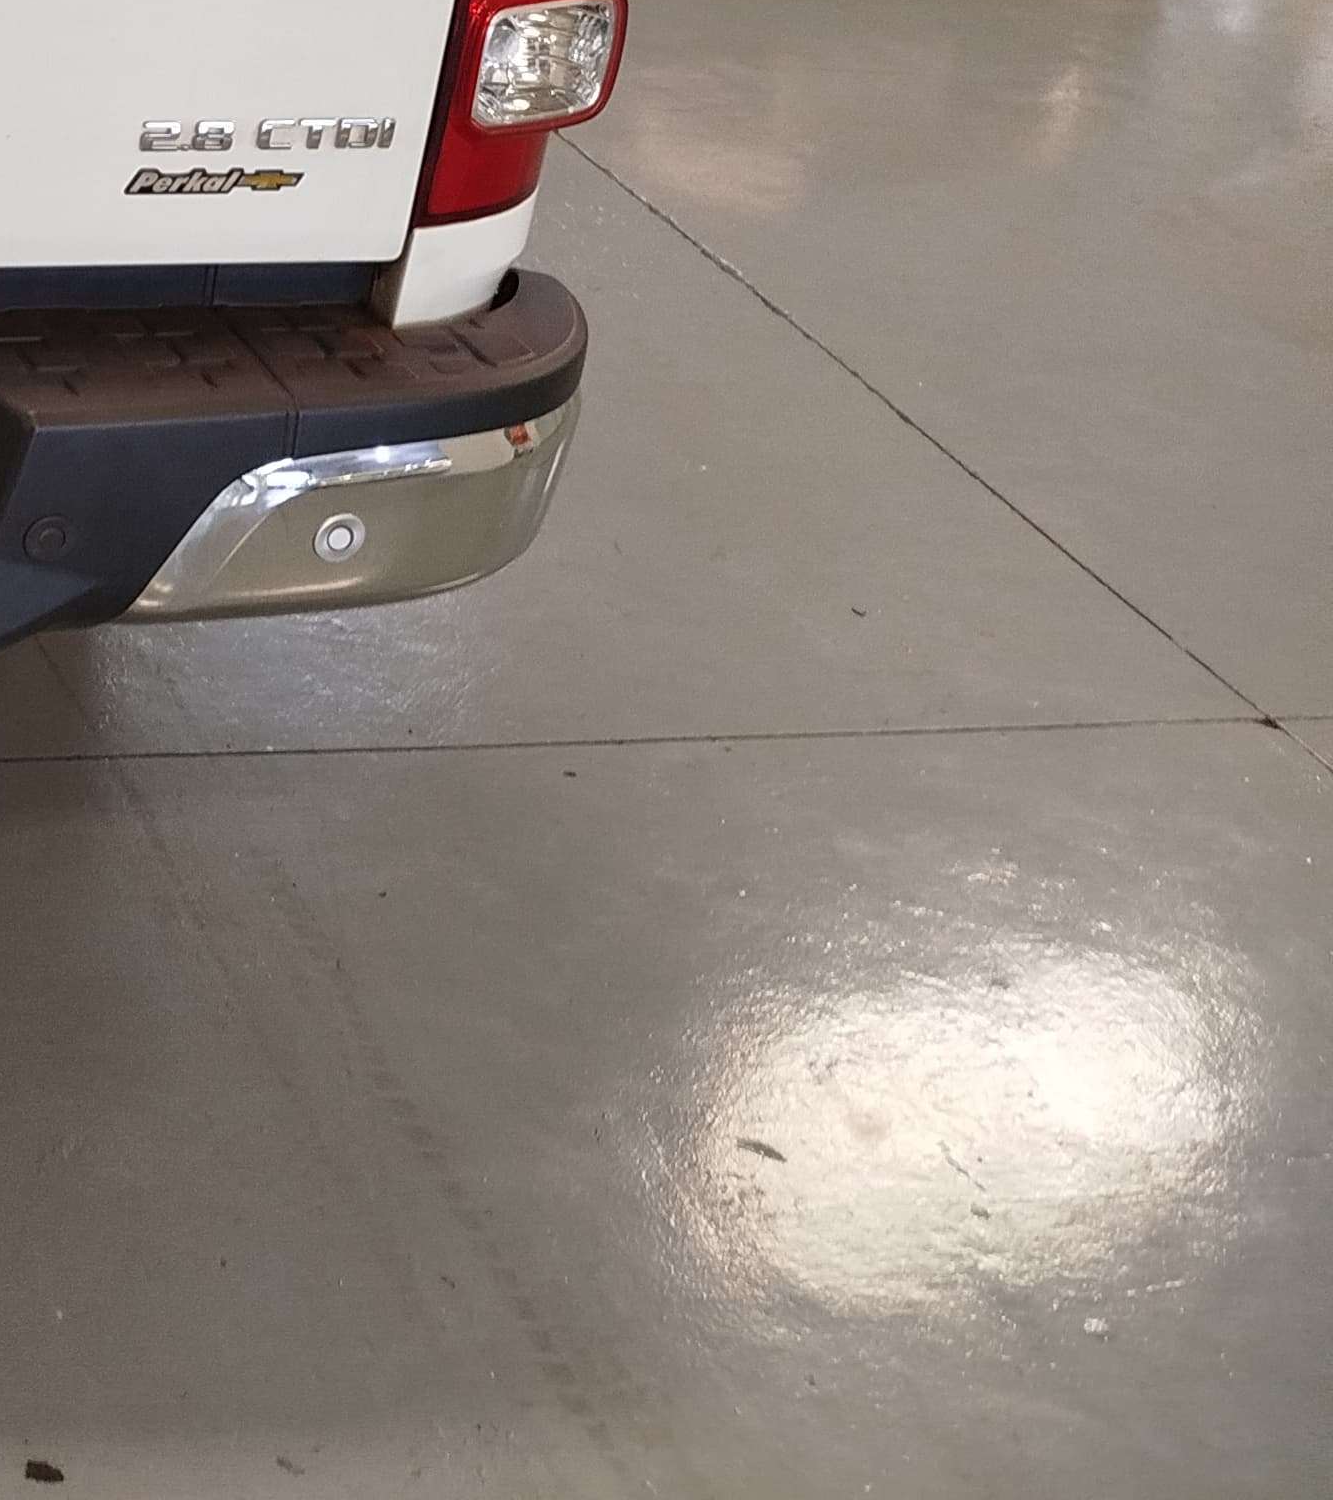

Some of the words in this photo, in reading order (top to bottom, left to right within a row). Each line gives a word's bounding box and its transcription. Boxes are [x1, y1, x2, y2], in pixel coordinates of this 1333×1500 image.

[137, 120, 235, 152] 2.8
[255, 116, 397, 151] CTDI
[129, 171, 240, 193] Perkal
